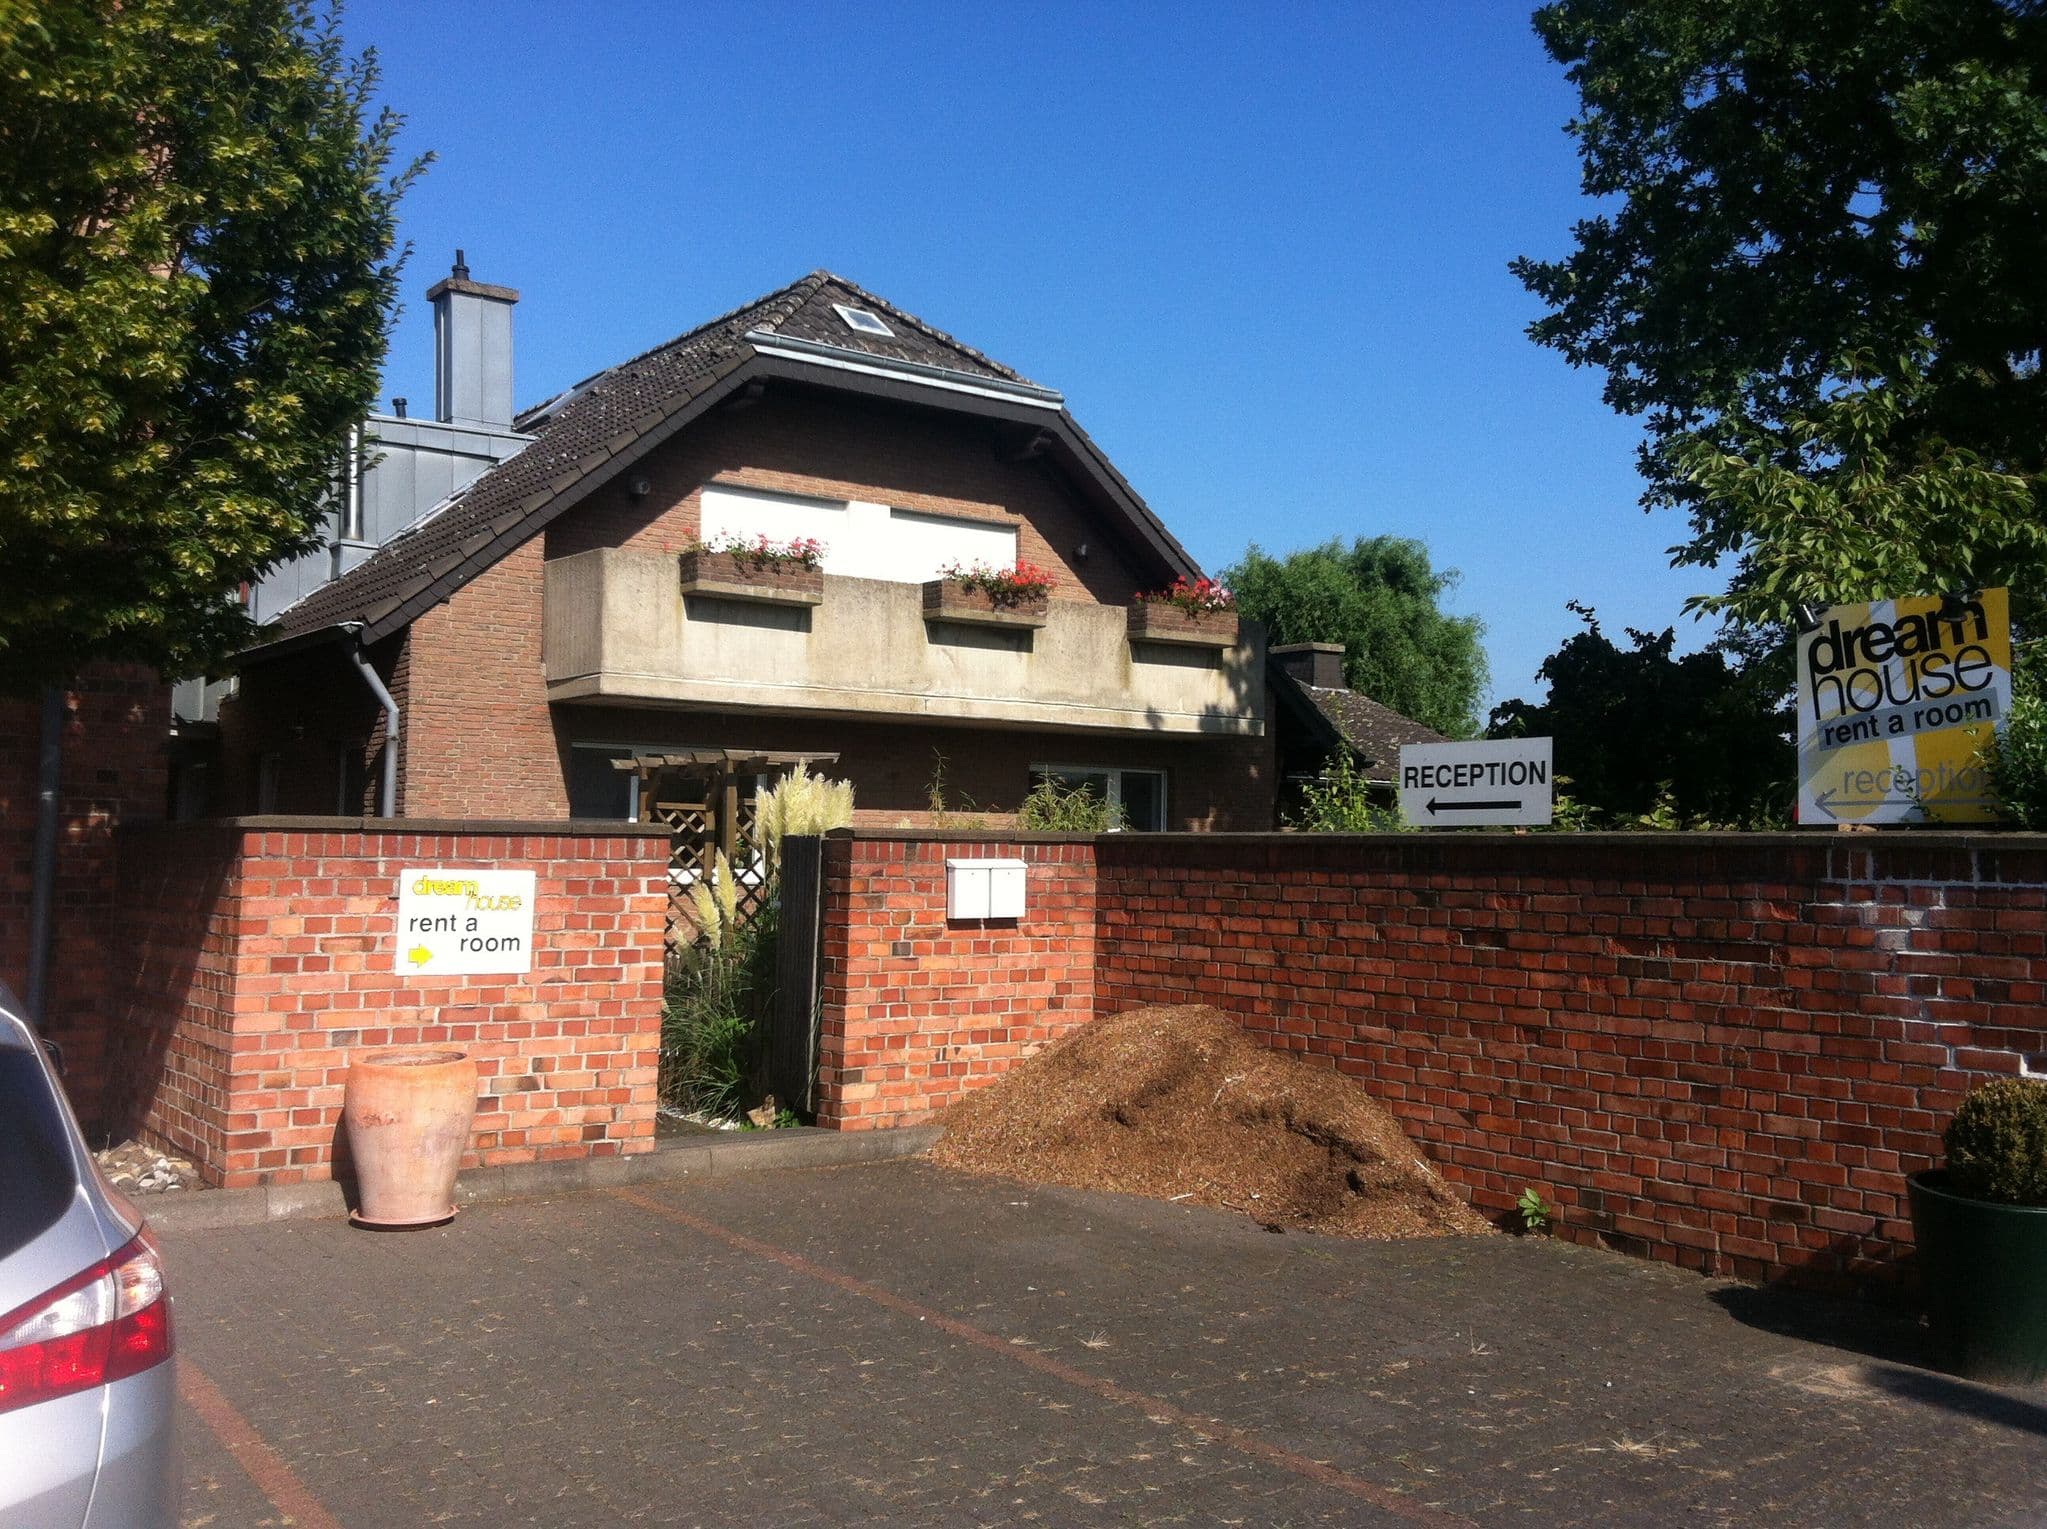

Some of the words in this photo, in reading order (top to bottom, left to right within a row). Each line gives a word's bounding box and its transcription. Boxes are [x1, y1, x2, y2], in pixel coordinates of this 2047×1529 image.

[1809, 602, 1988, 674] dream
[1811, 646, 1993, 720] house
[1824, 717, 1879, 745] rent
[1888, 714, 1904, 733] a
[1914, 698, 1991, 729] room
[1404, 761, 1546, 789] RECEPTION
[412, 875, 480, 896] dream
[465, 890, 522, 911] house
[409, 914, 456, 932] rent
[465, 917, 478, 932] a
[460, 937, 521, 952] room
